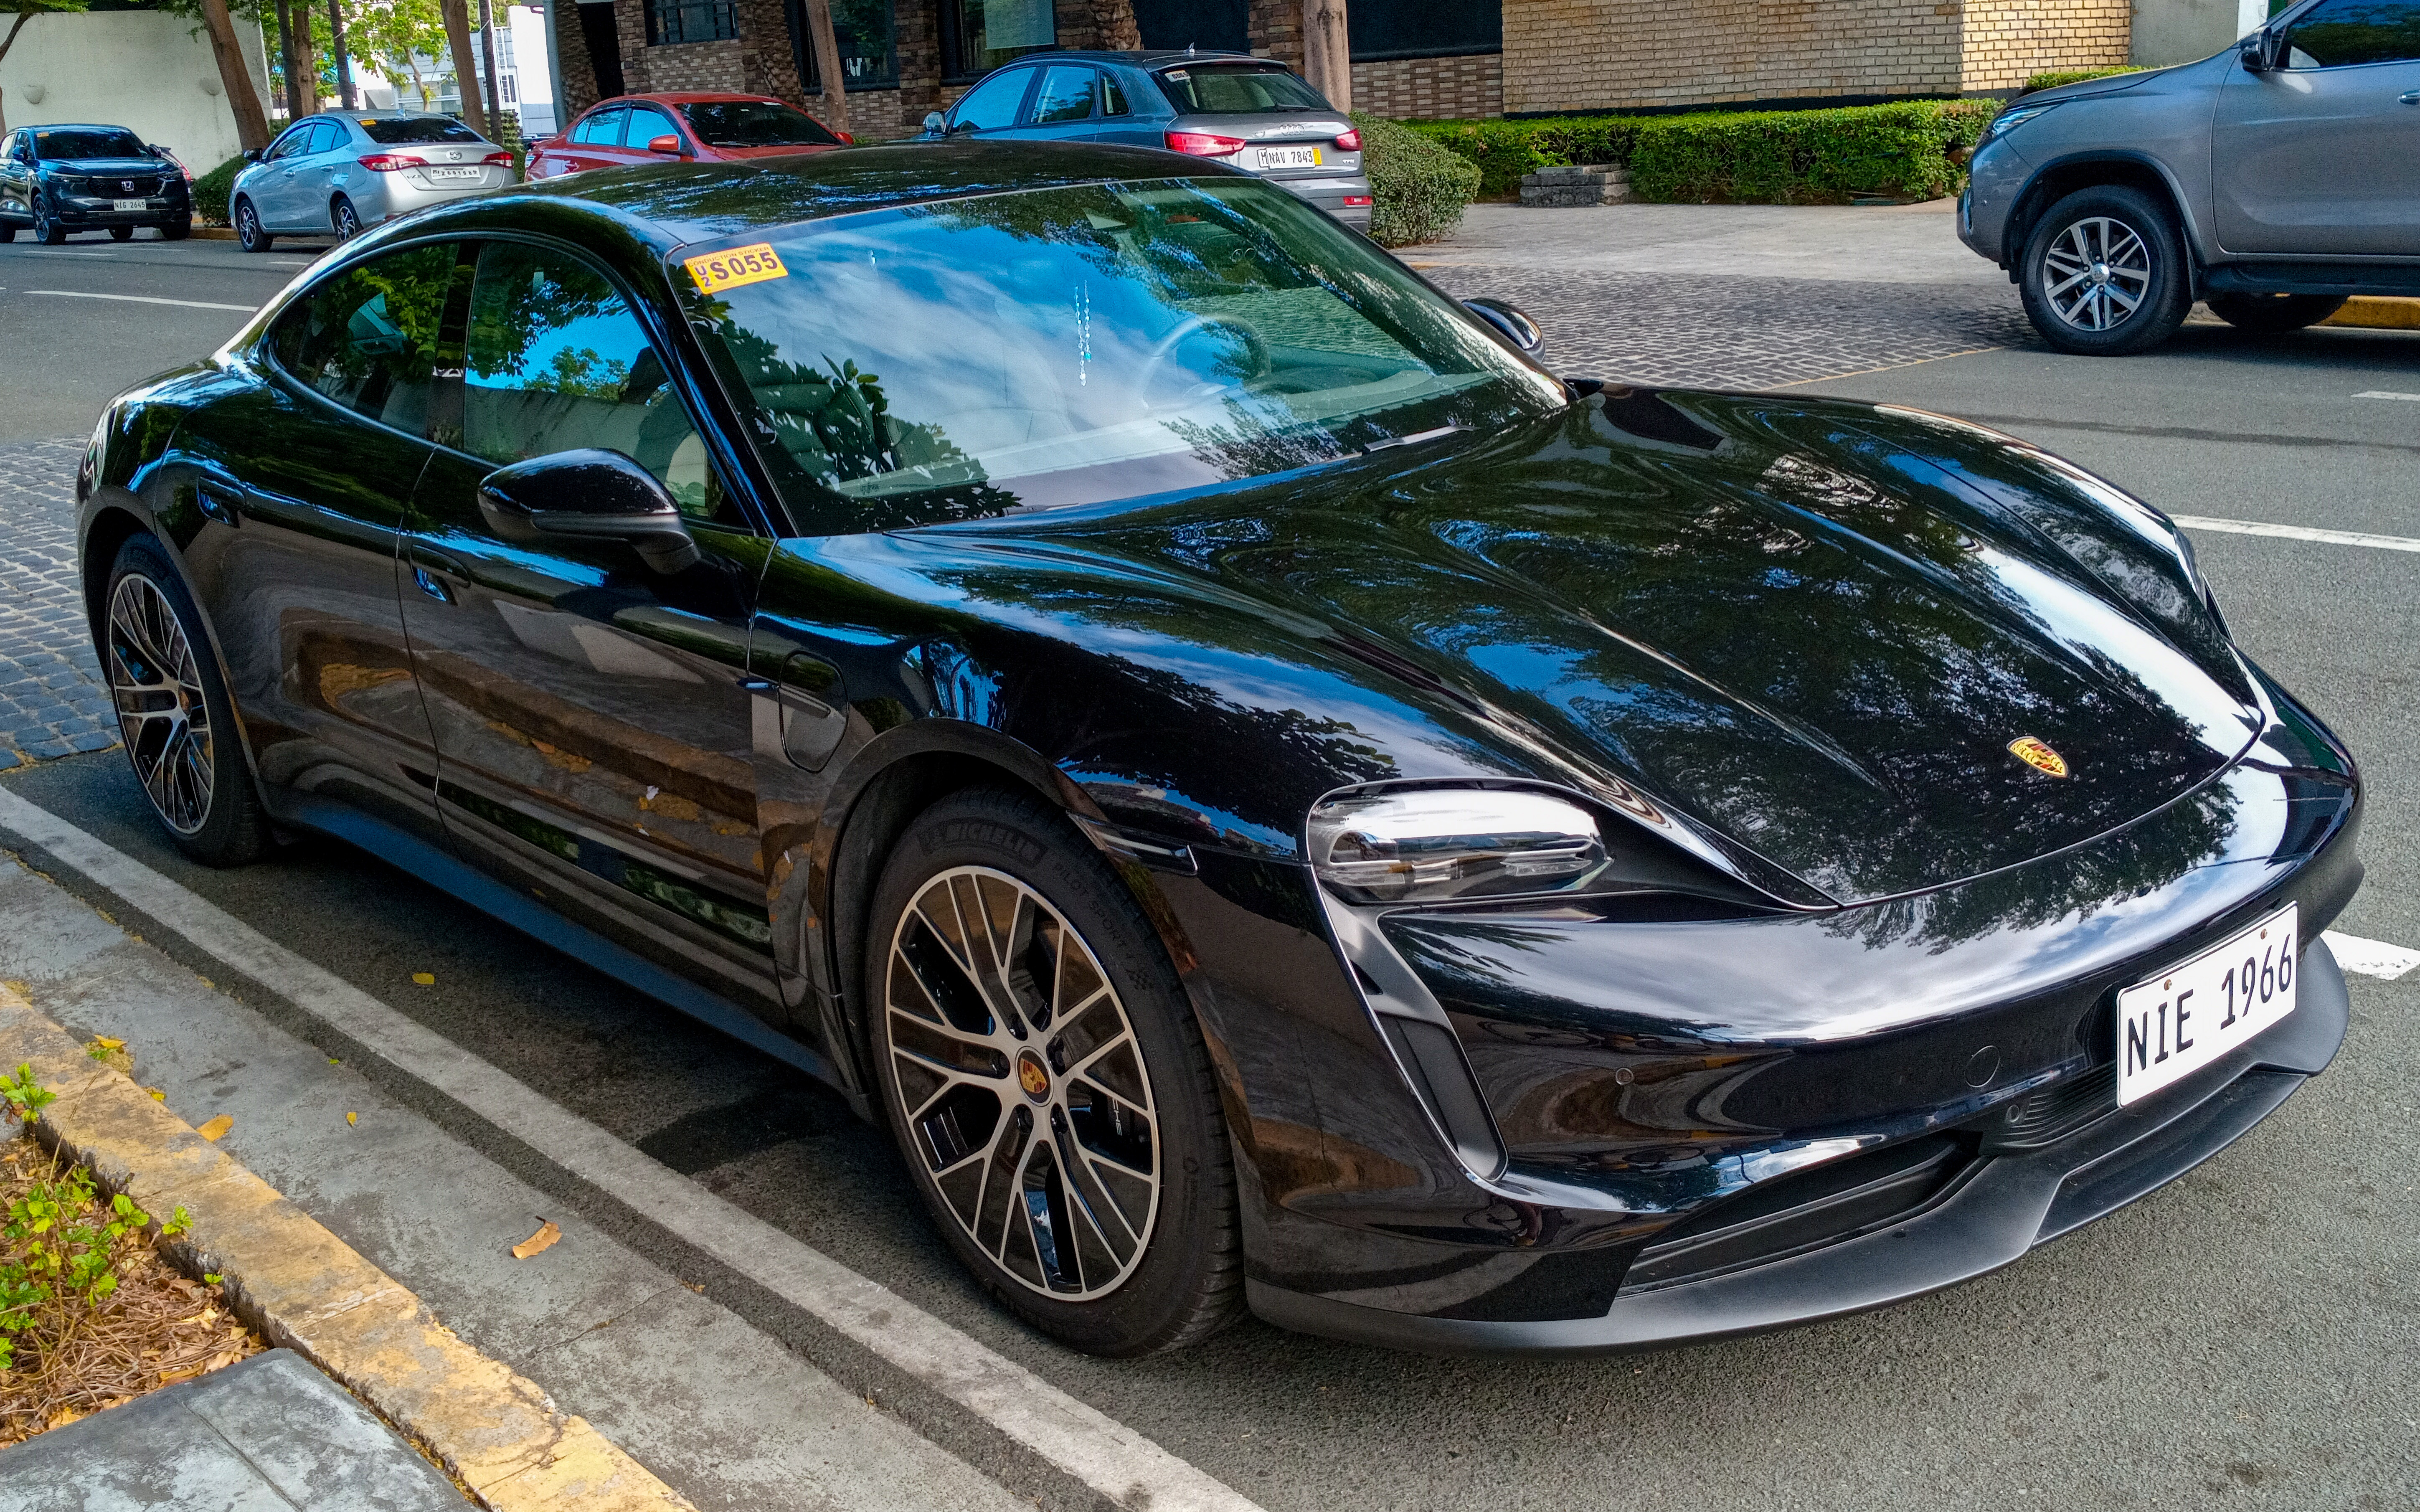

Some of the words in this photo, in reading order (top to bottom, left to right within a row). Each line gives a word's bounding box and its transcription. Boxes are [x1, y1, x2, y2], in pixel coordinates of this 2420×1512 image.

[1269, 152, 1285, 164] NAV
[1291, 151, 1313, 163] 7843
[688, 253, 737, 267] CONDUCTION
[738, 246, 770, 256] STICKER
[710, 252, 778, 280] S055
[695, 265, 707, 276] U
[701, 277, 713, 287] 2
[946, 823, 1041, 862] MICHELIN
[1088, 900, 1127, 949] SPORT
[2127, 988, 2194, 1077] NIE
[2220, 934, 2293, 1030] 1966
